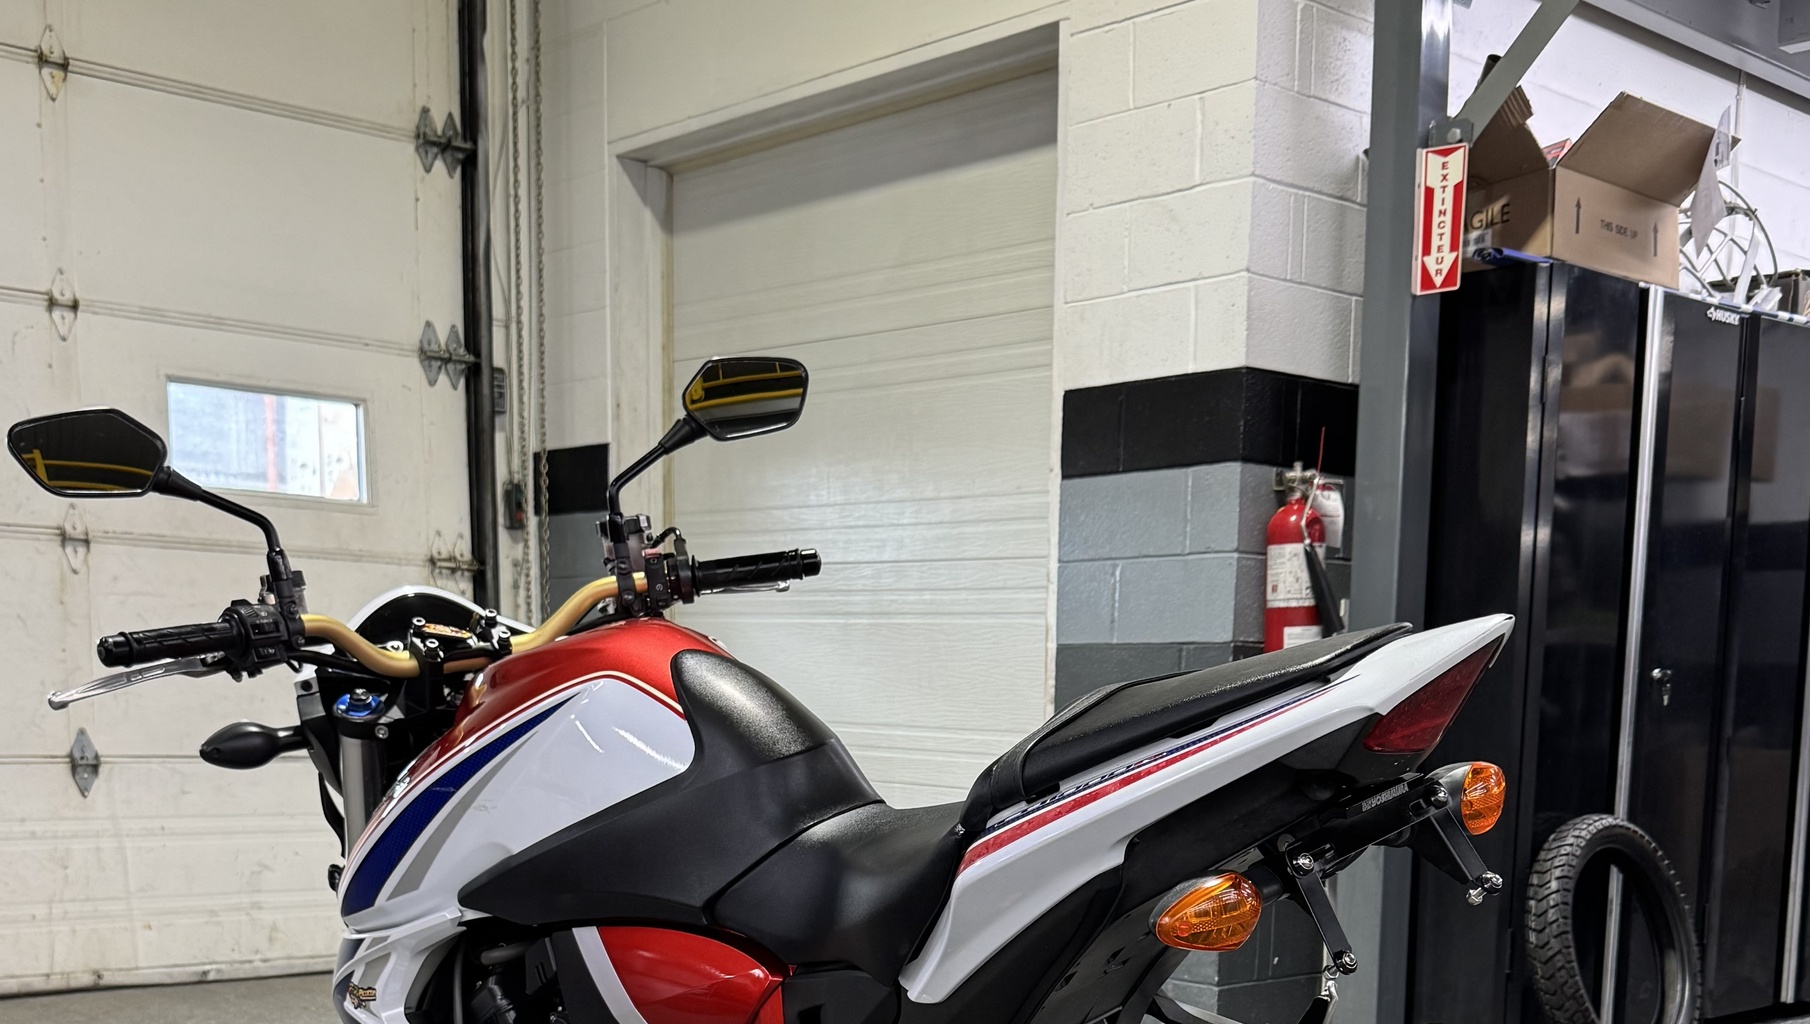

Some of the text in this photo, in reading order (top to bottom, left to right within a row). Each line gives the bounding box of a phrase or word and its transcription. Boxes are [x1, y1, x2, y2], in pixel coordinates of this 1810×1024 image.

[1434, 160, 1449, 277] EXTINCTEUR
[1600, 219, 1613, 233] THIS
[1615, 224, 1629, 237] SIDE
[1716, 309, 1740, 325] HUSKY
